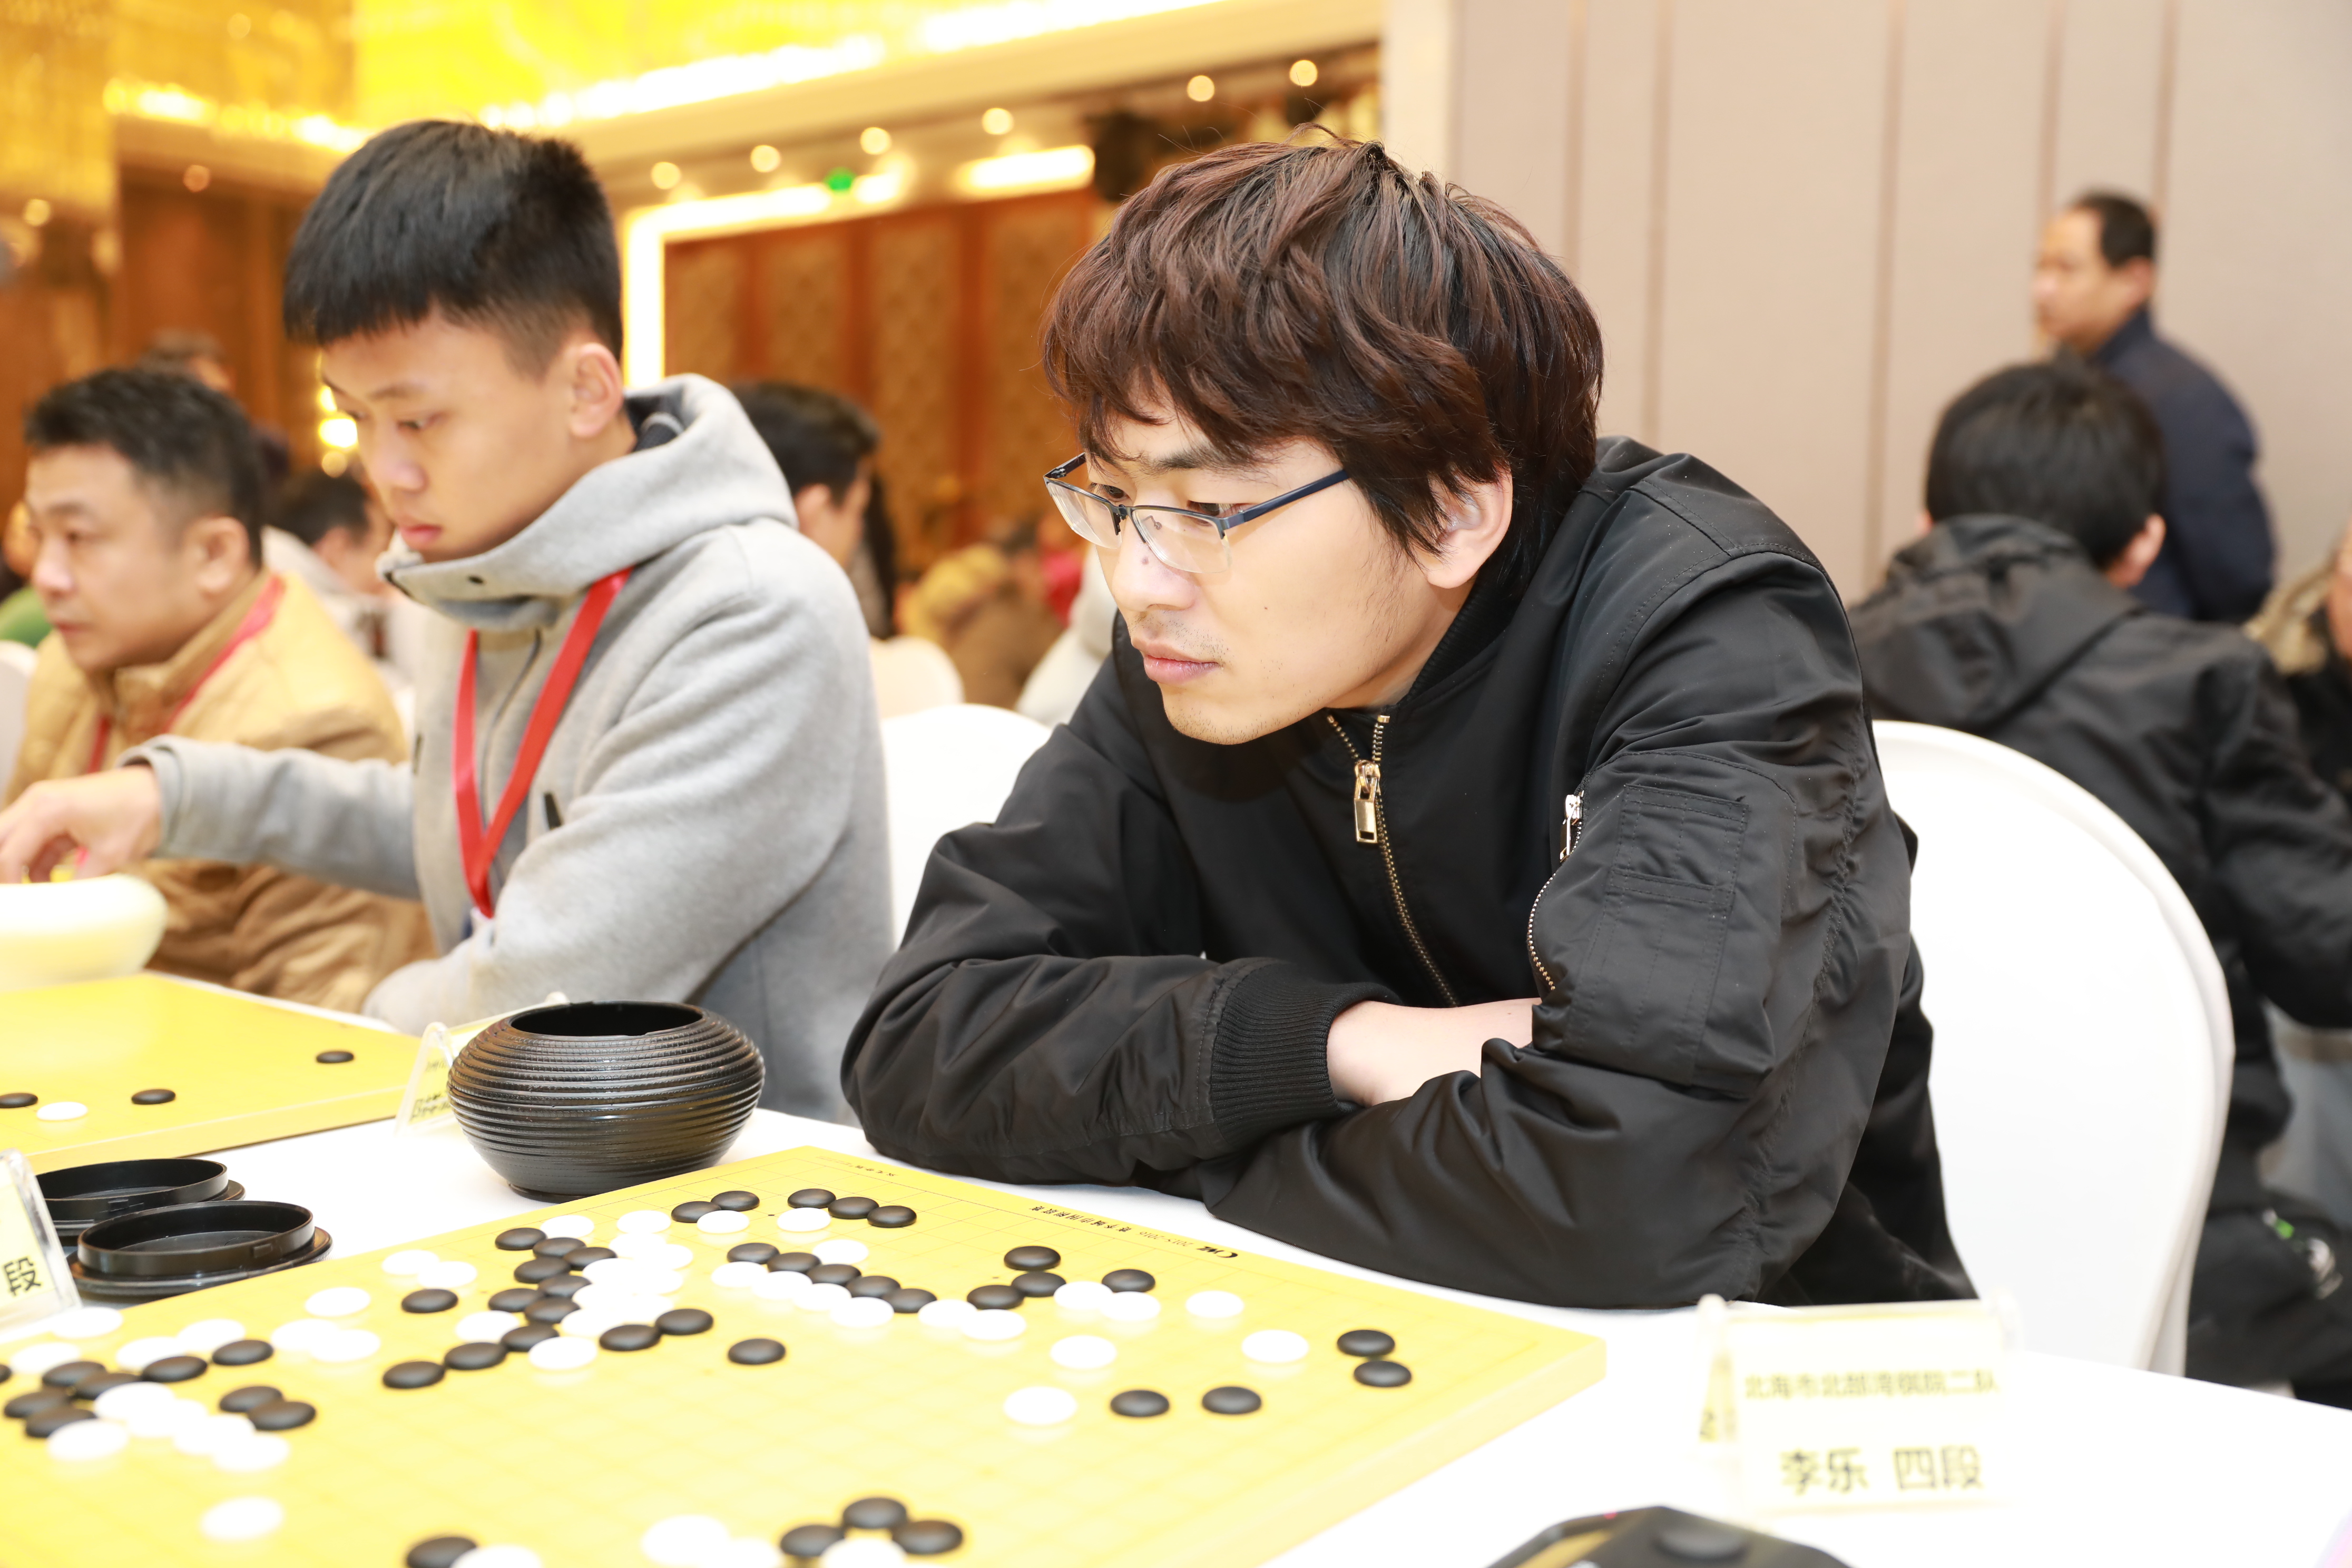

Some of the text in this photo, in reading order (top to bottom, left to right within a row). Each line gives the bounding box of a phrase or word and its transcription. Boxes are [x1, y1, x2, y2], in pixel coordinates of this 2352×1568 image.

[1139, 1231, 1194, 1247] 2015-2016
[3, 1256, 41, 1296] 段
[1780, 1446, 1983, 1494] 李乐 四段
